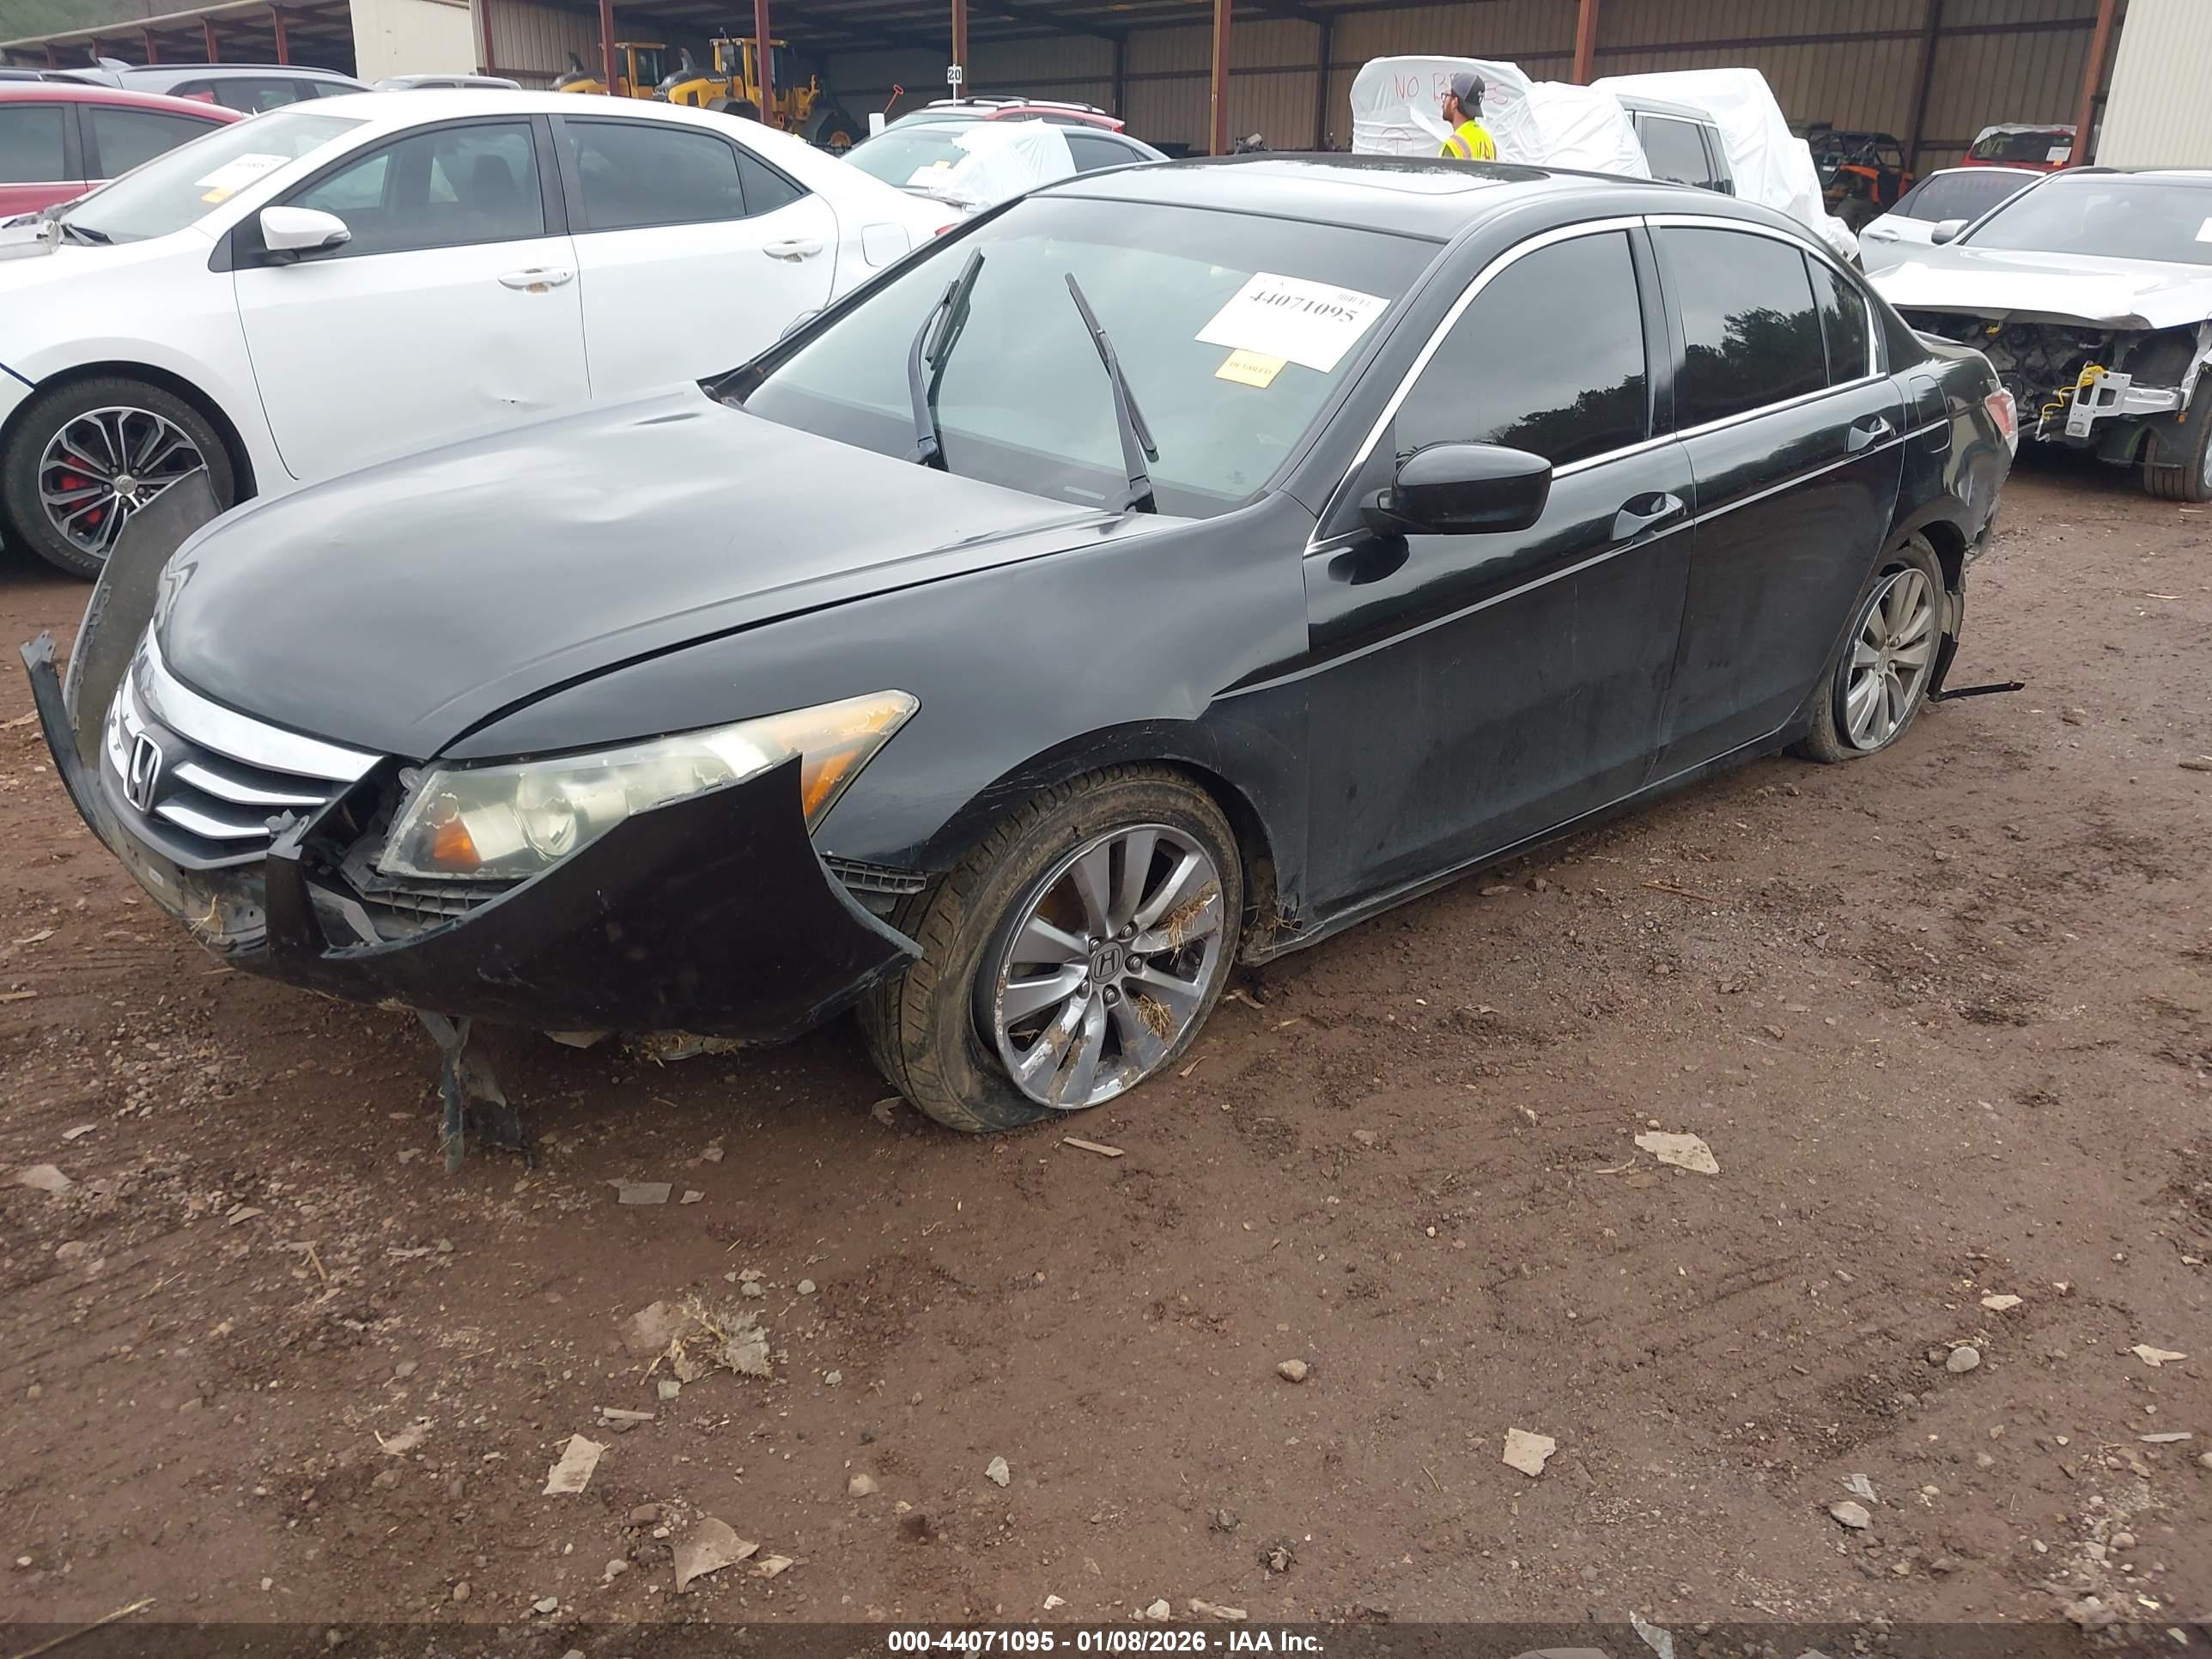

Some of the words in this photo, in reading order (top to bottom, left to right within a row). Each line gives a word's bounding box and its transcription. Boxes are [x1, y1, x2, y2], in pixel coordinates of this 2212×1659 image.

[948, 69, 961, 81] 20
[1394, 73, 1419, 100] NO
[1249, 290, 1359, 323] 44071095
